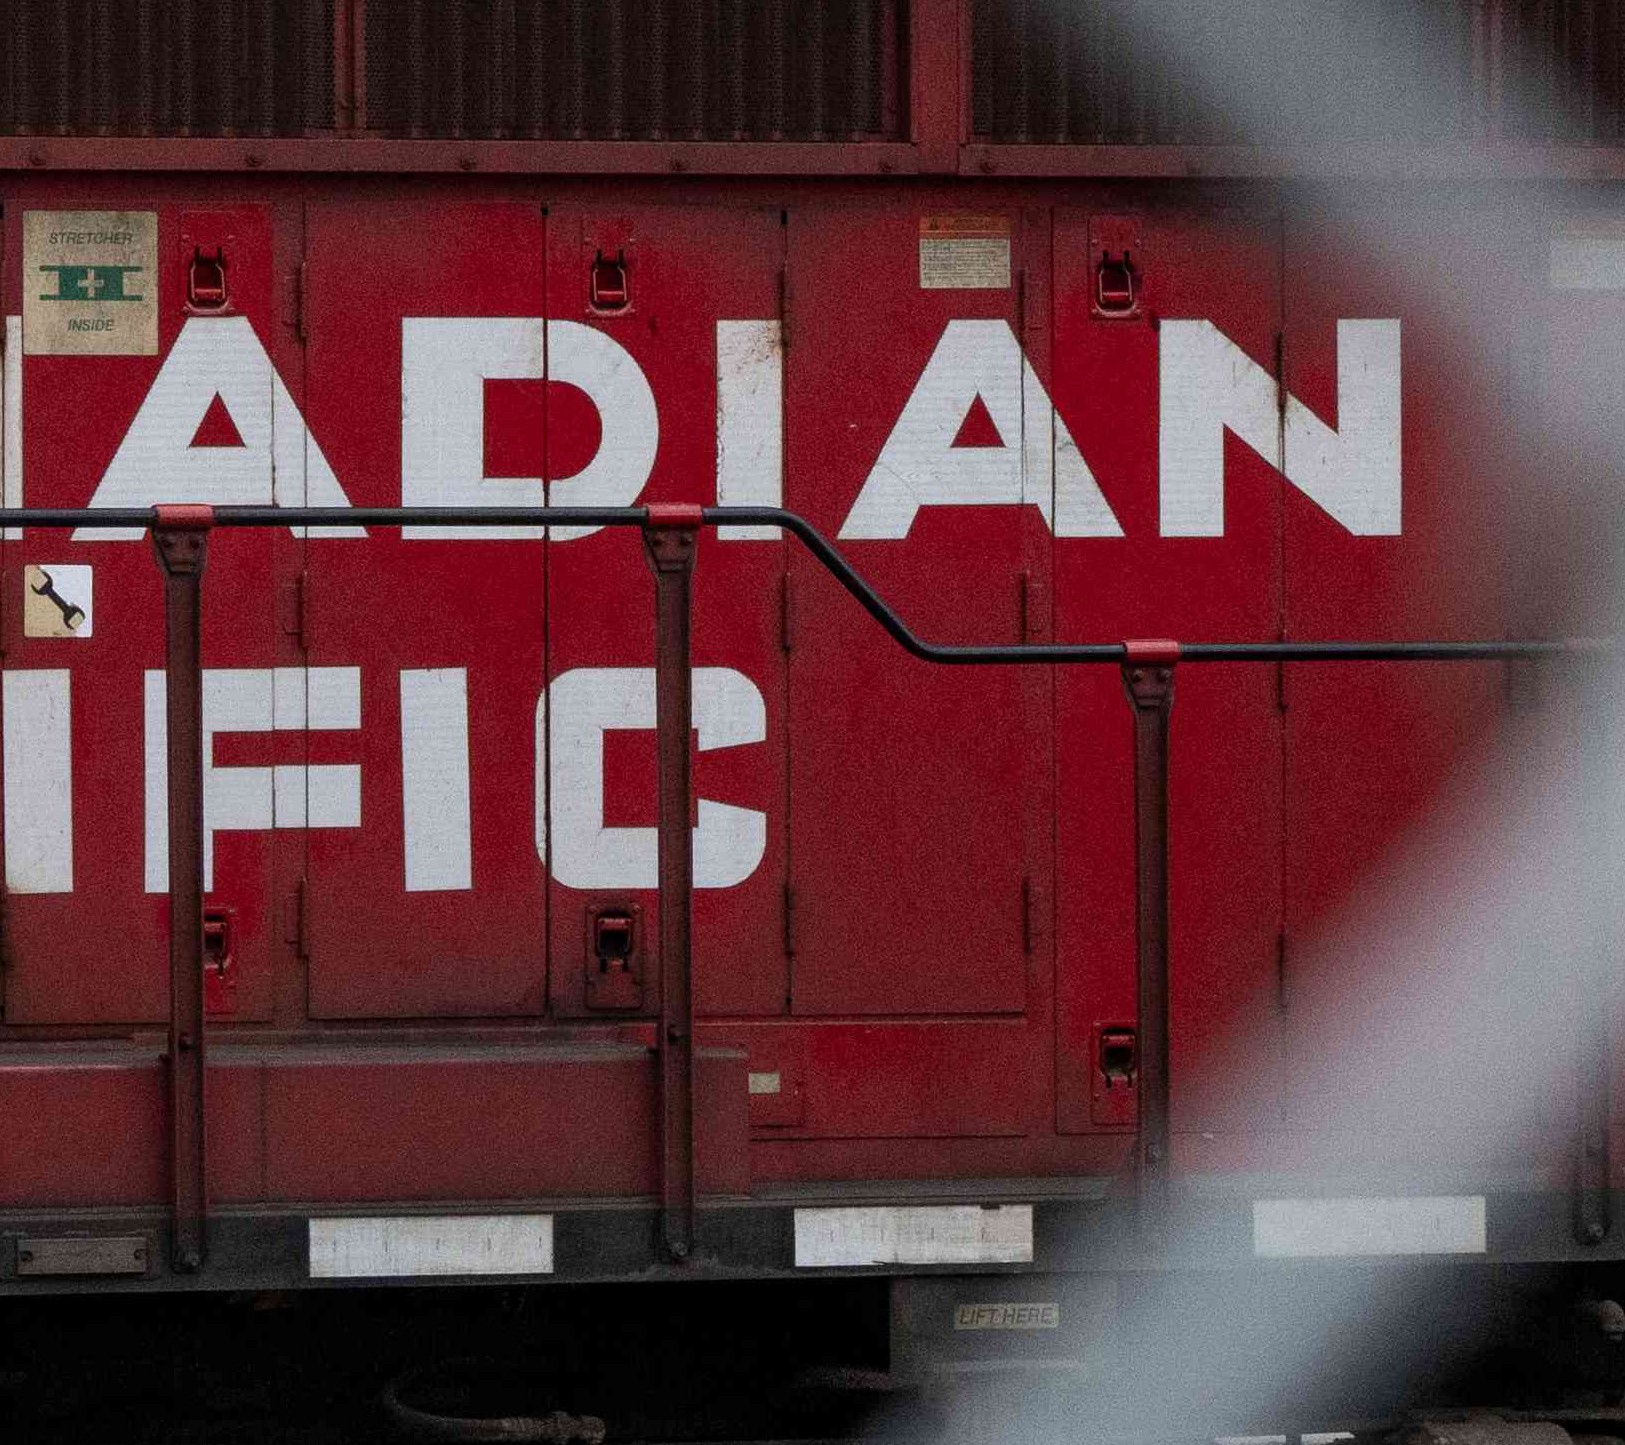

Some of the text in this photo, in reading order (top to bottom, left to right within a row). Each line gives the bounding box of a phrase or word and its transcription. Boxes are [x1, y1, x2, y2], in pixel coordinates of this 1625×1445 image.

[48, 231, 134, 245] STRETCHER
[67, 318, 115, 333] INSIDE
[958, 1306, 1054, 1325] LIFT HERE
